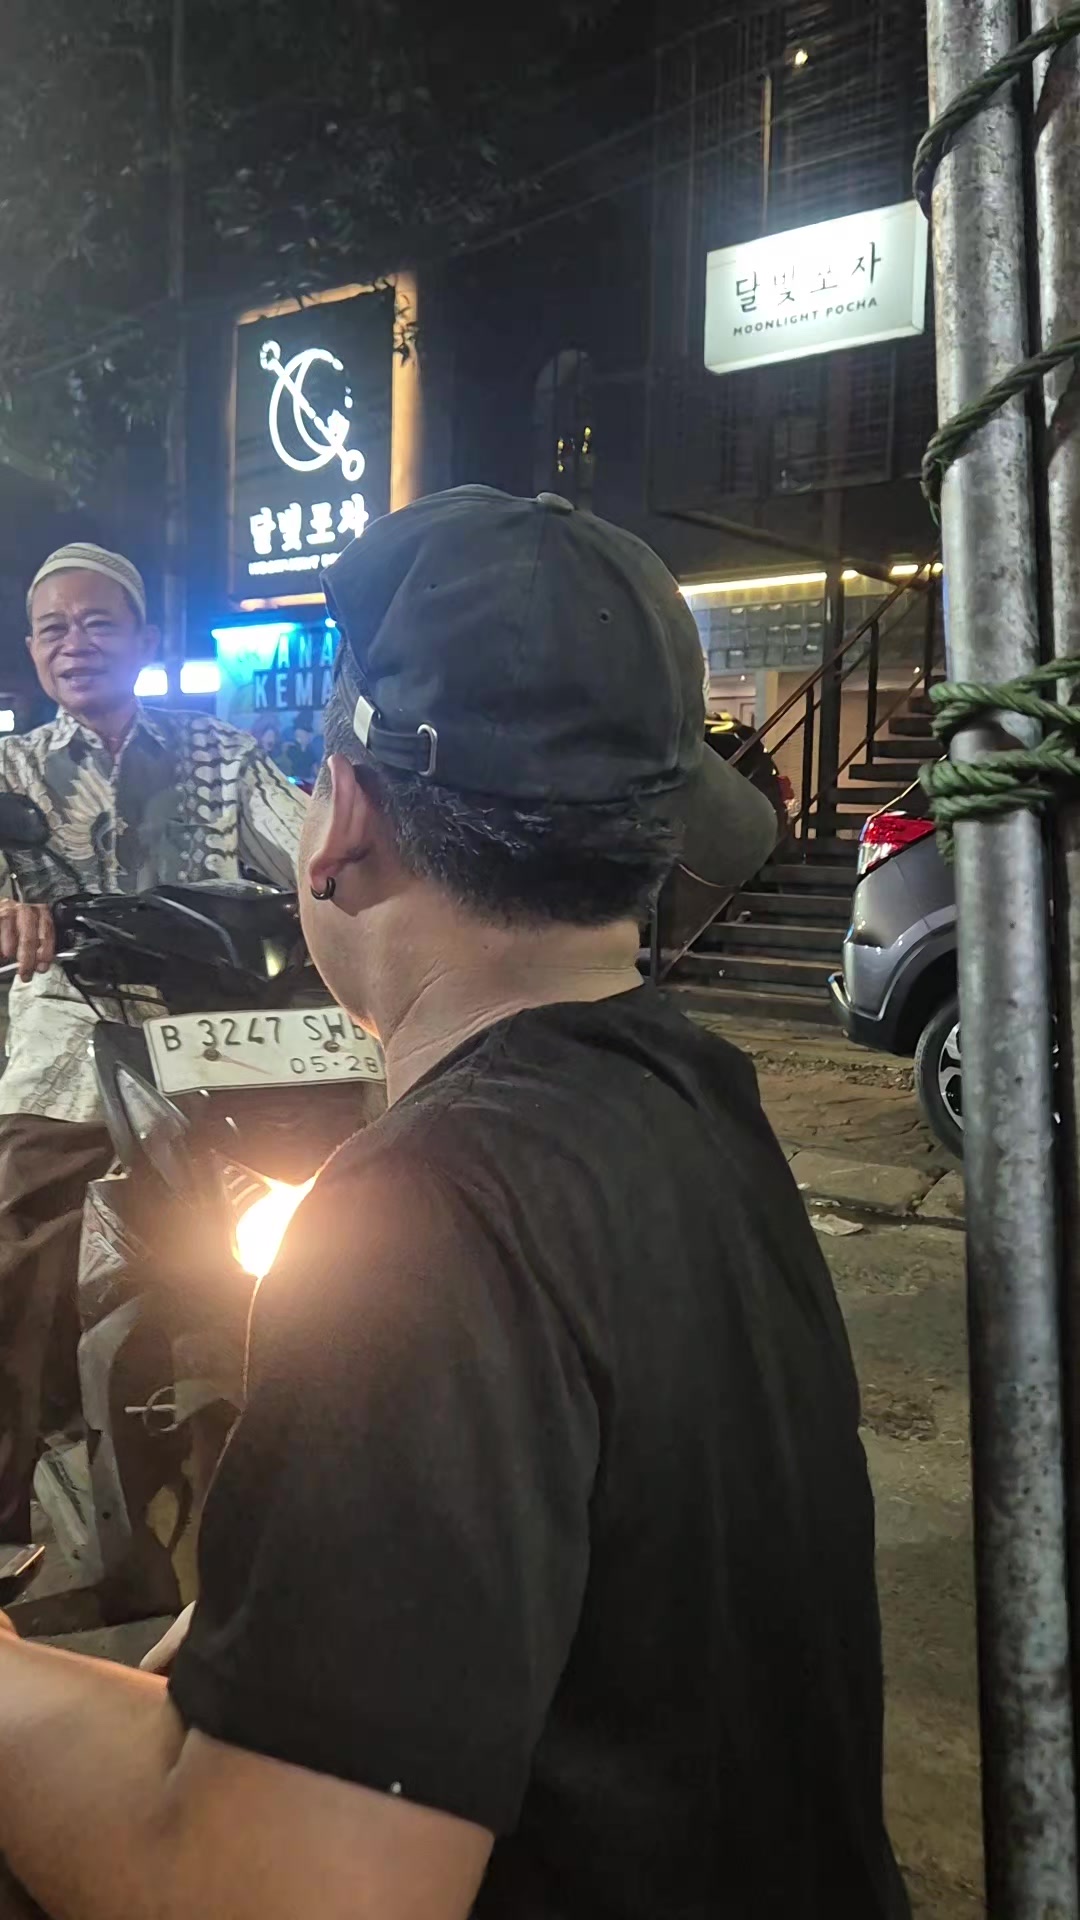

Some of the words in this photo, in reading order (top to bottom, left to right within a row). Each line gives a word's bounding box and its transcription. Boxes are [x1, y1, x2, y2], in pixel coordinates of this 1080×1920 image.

[732, 310, 819, 337] MOONLIGHT
[825, 296, 879, 318] POCHA
[160, 1024, 182, 1052] B
